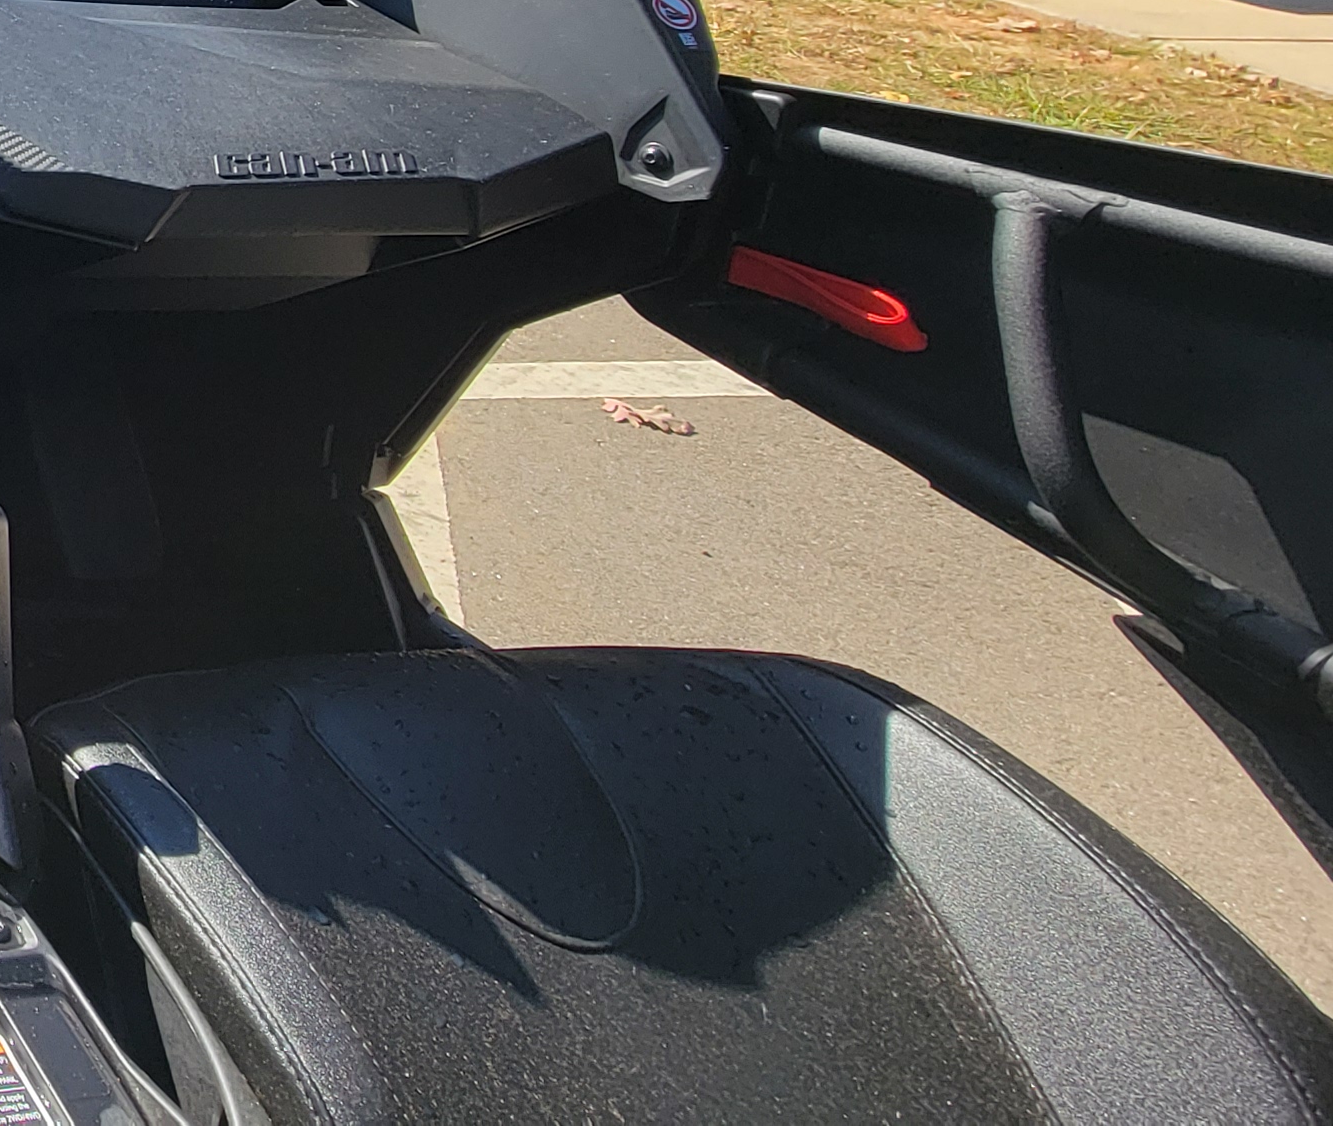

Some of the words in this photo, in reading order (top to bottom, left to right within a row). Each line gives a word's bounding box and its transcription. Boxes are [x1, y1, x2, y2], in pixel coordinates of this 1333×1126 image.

[214, 149, 420, 179] can-am
[7, 1094, 25, 1104] apply
[0, 1105, 19, 1114] using
